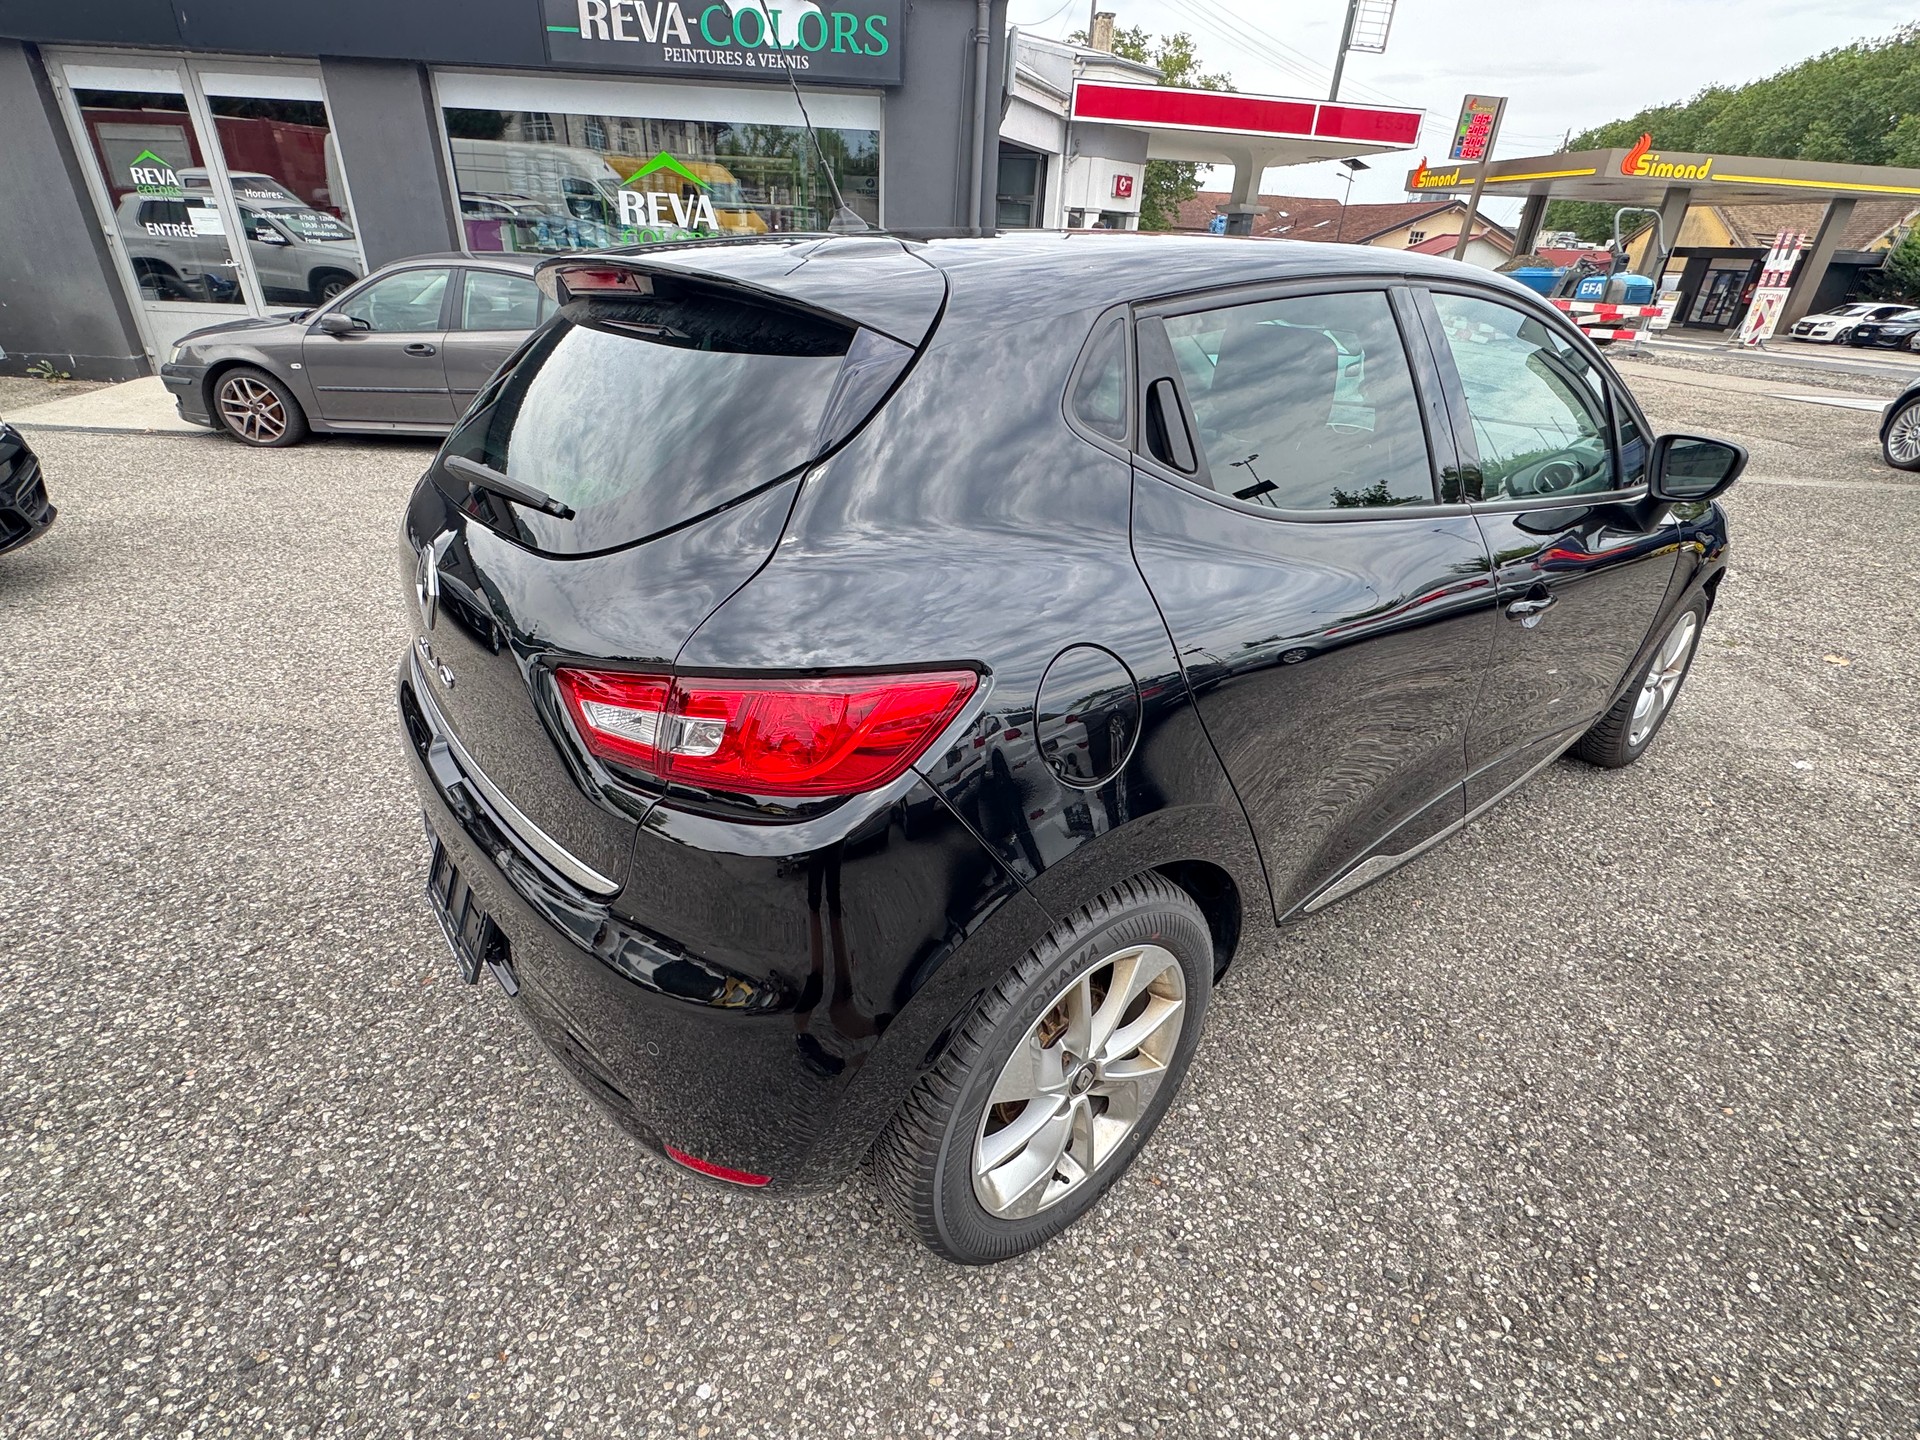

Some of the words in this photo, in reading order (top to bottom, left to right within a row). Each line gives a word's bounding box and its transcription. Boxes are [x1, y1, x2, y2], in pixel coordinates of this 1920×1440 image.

[578, 0, 889, 56] REVA-COLORS
[664, 47, 743, 66] PEINTURES
[745, 54, 756, 66] &
[757, 53, 809, 70] VERNIS
[129, 167, 180, 186] REVA
[1633, 153, 1713, 180] Simond
[1417, 167, 1461, 188] Simond
[136, 184, 185, 197] COLORS
[245, 188, 284, 199] Horaires:
[617, 190, 720, 230] REVA
[145, 221, 198, 238] ENTRÉE
[1581, 282, 1602, 295] EFA
[999, 943, 1099, 1053] YOKOHAMA
